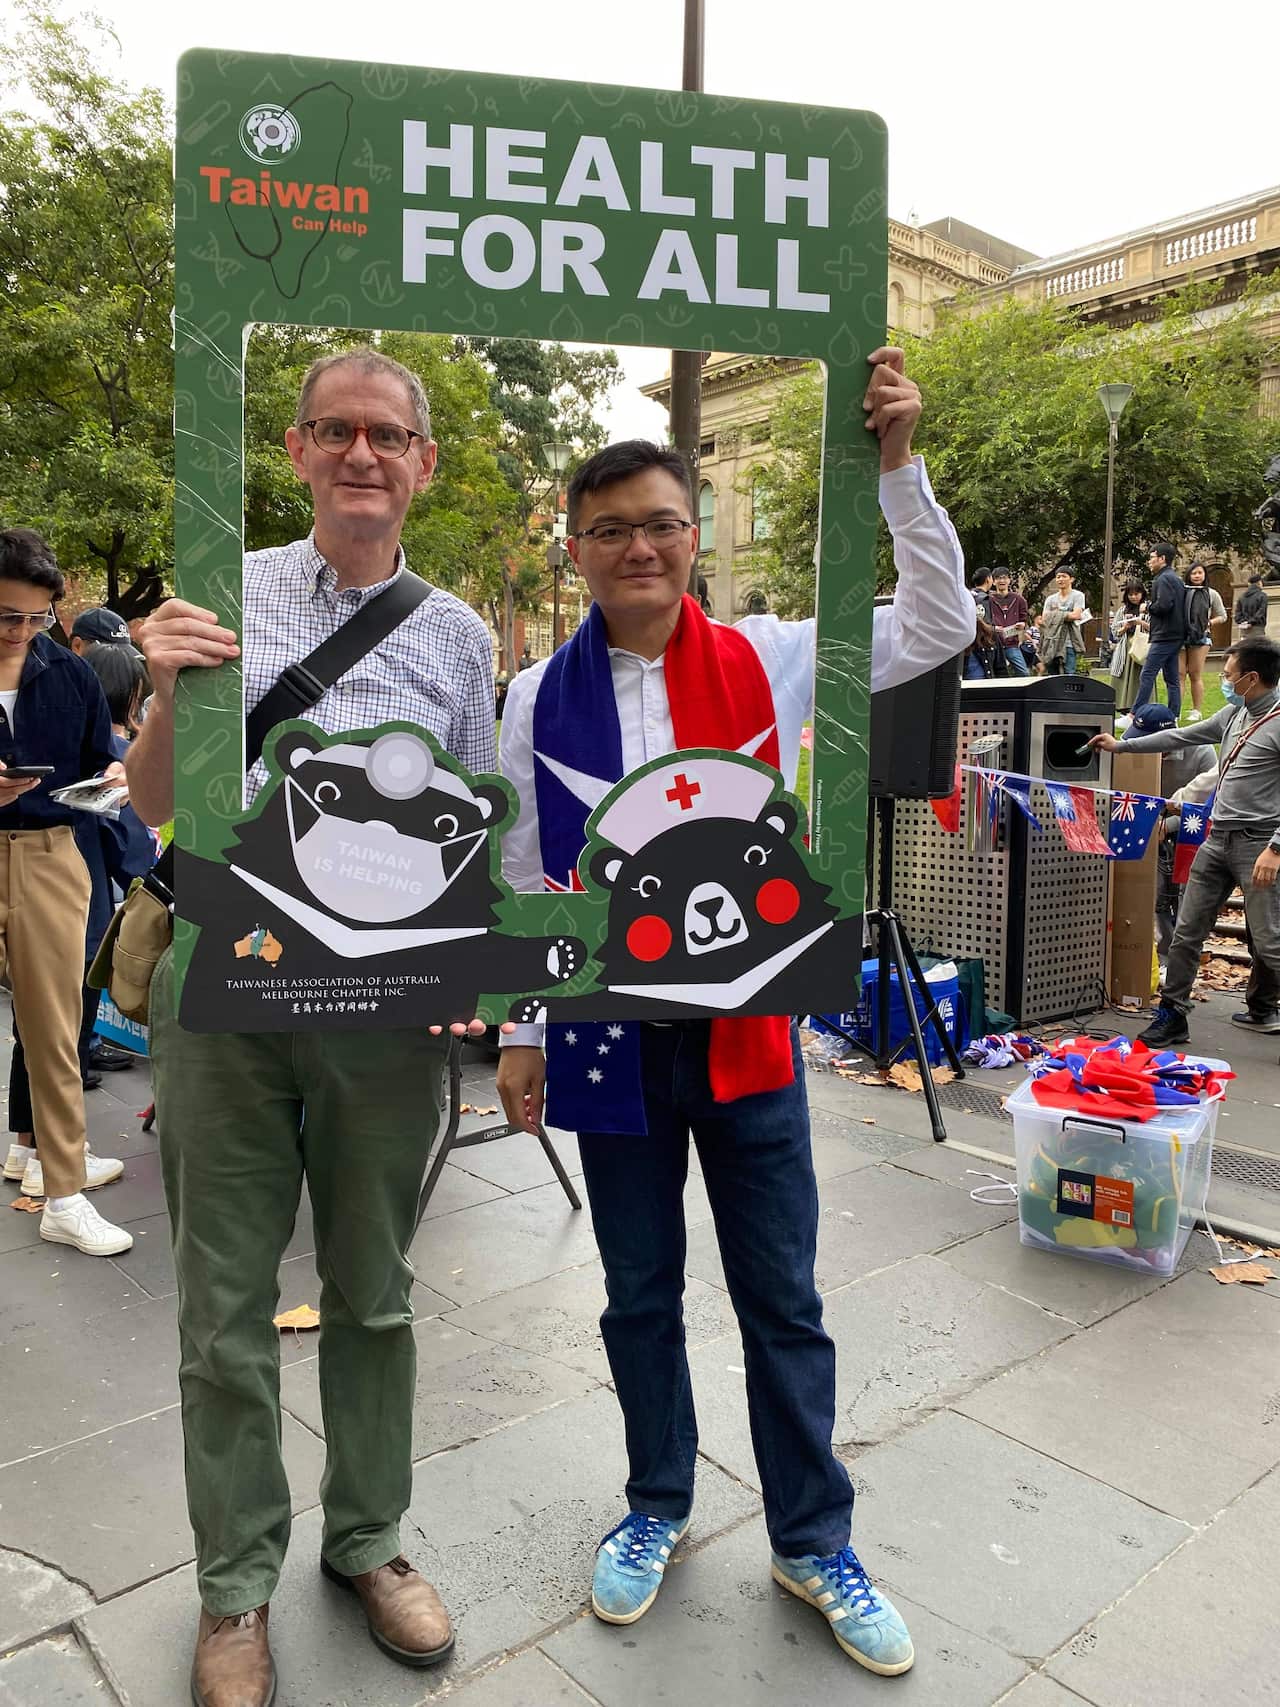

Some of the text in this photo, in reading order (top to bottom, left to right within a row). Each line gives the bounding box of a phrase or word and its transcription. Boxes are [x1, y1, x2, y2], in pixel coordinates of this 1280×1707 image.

[200, 166, 369, 214] Taiwan
[403, 120, 830, 228] HEALTH
[292, 216, 368, 237] Can Help
[403, 209, 830, 313] FOR ALL
[337, 839, 413, 872] TAIWAN
[313, 855, 423, 896] IS HELPING
[225, 975, 441, 989] TAIWANESE ASSOCIATION OF AUSTRALIA
[261, 989, 329, 1000] MELBOURNE
[331, 988, 381, 998] CHAPTER
